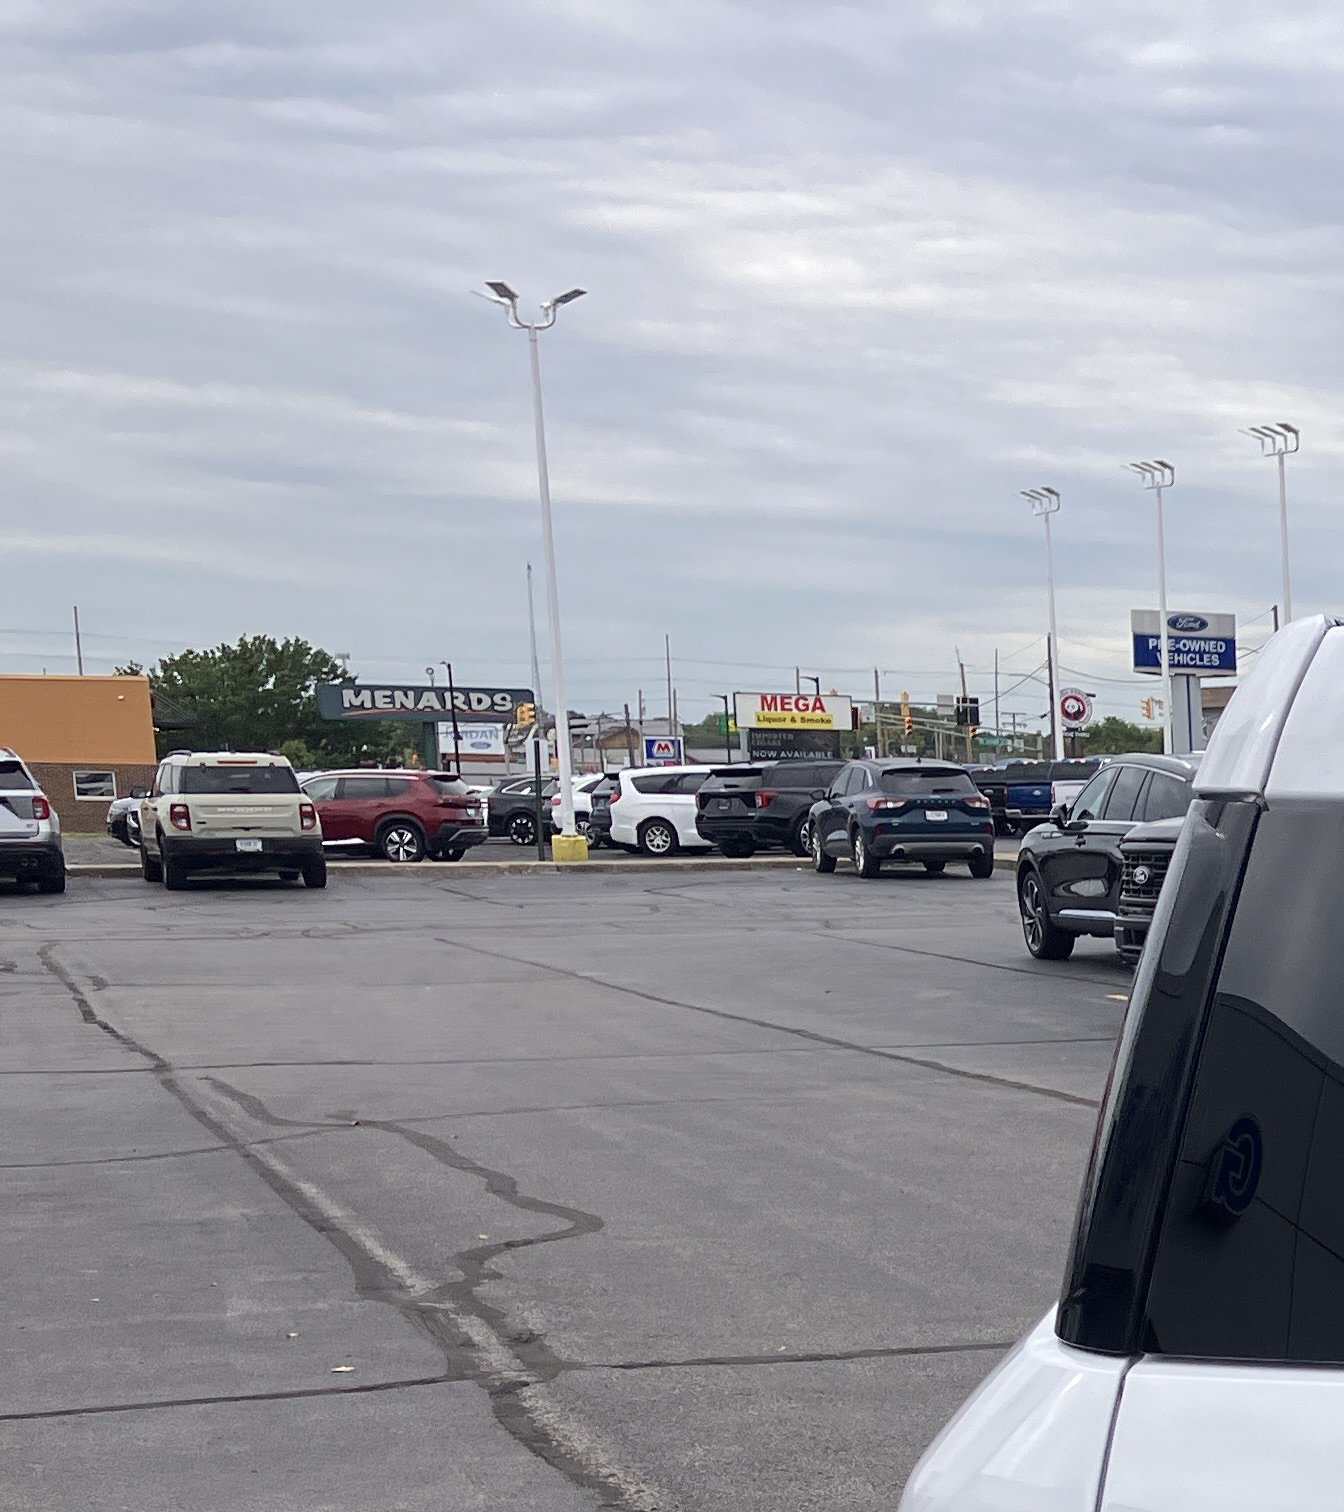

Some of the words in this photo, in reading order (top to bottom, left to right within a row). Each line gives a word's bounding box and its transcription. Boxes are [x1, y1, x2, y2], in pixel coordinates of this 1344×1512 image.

[1176, 617, 1201, 629] Ford
[342, 689, 513, 712] MENARDS
[760, 695, 826, 713] MEGA
[757, 714, 787, 724] Liquor
[800, 716, 832, 724] Smoke
[752, 750, 778, 758] NOW
[780, 750, 834, 760] AVAILABLE
